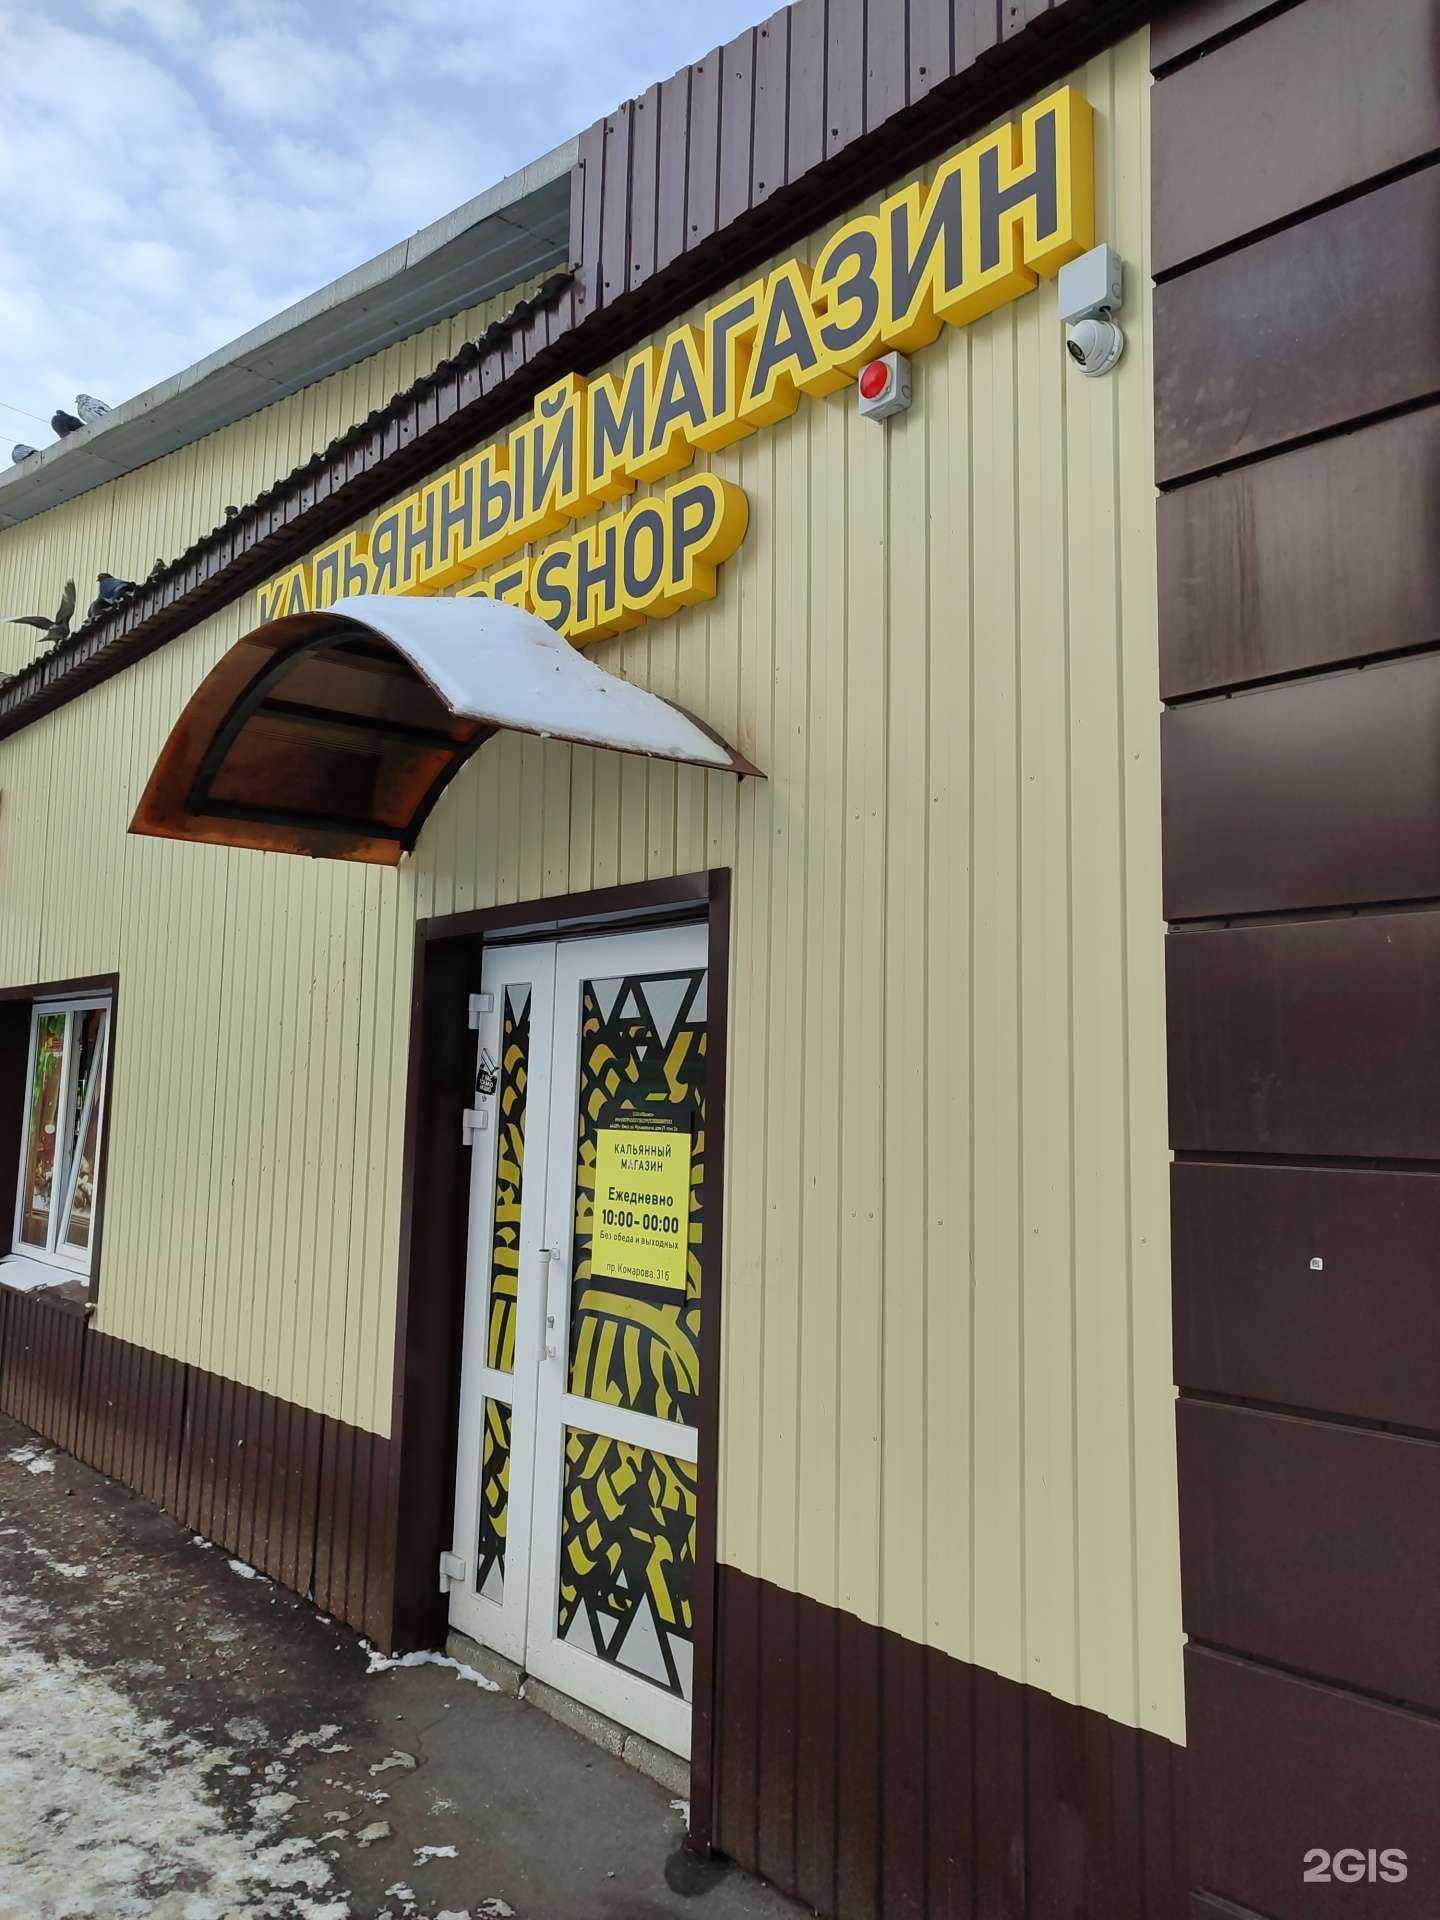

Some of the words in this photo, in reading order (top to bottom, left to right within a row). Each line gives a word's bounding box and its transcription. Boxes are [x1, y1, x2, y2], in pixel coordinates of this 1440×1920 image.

[593, 108, 1058, 478] МАГАЗИН
[614, 1143, 672, 1158] КАЛЬЯННЫЙ
[620, 1159, 663, 1173] МАГАЗИН
[608, 1187, 674, 1207] Ежедневно
